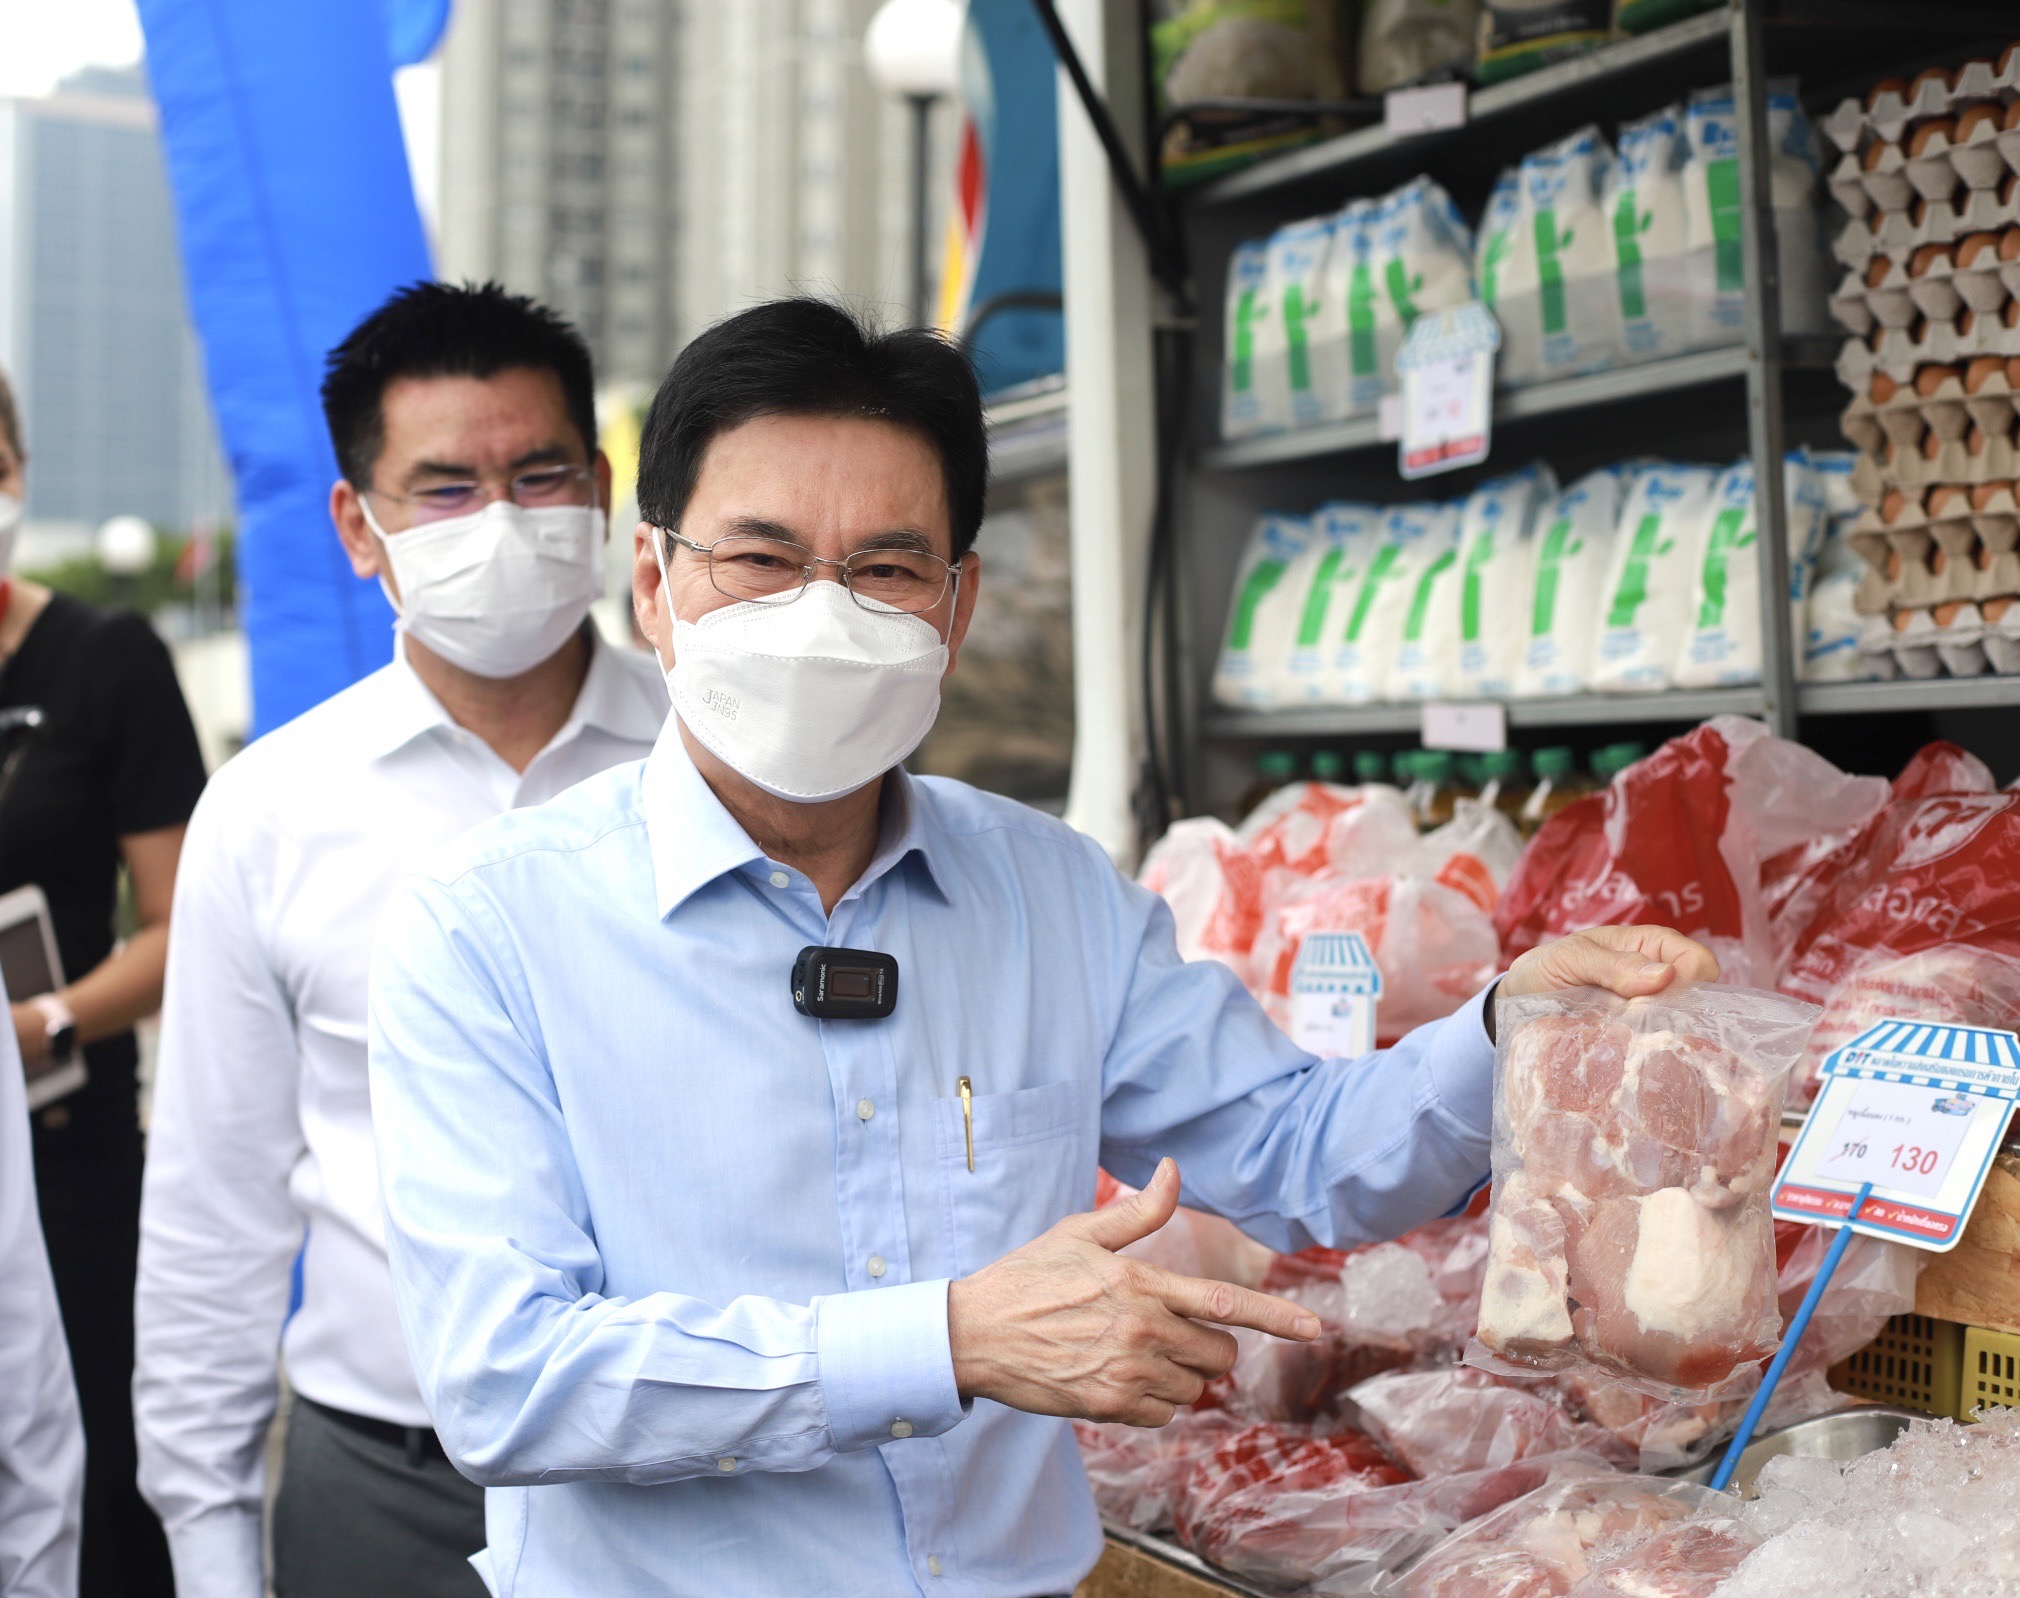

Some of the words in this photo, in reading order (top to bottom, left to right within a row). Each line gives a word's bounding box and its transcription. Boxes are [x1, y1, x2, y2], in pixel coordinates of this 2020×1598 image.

[702, 689, 741, 710] JAPAN
[711, 702, 738, 721] JN95
[816, 963, 827, 1002] Saramonic
[1842, 1141, 1868, 1158] 170
[1890, 1143, 1938, 1175] 130
